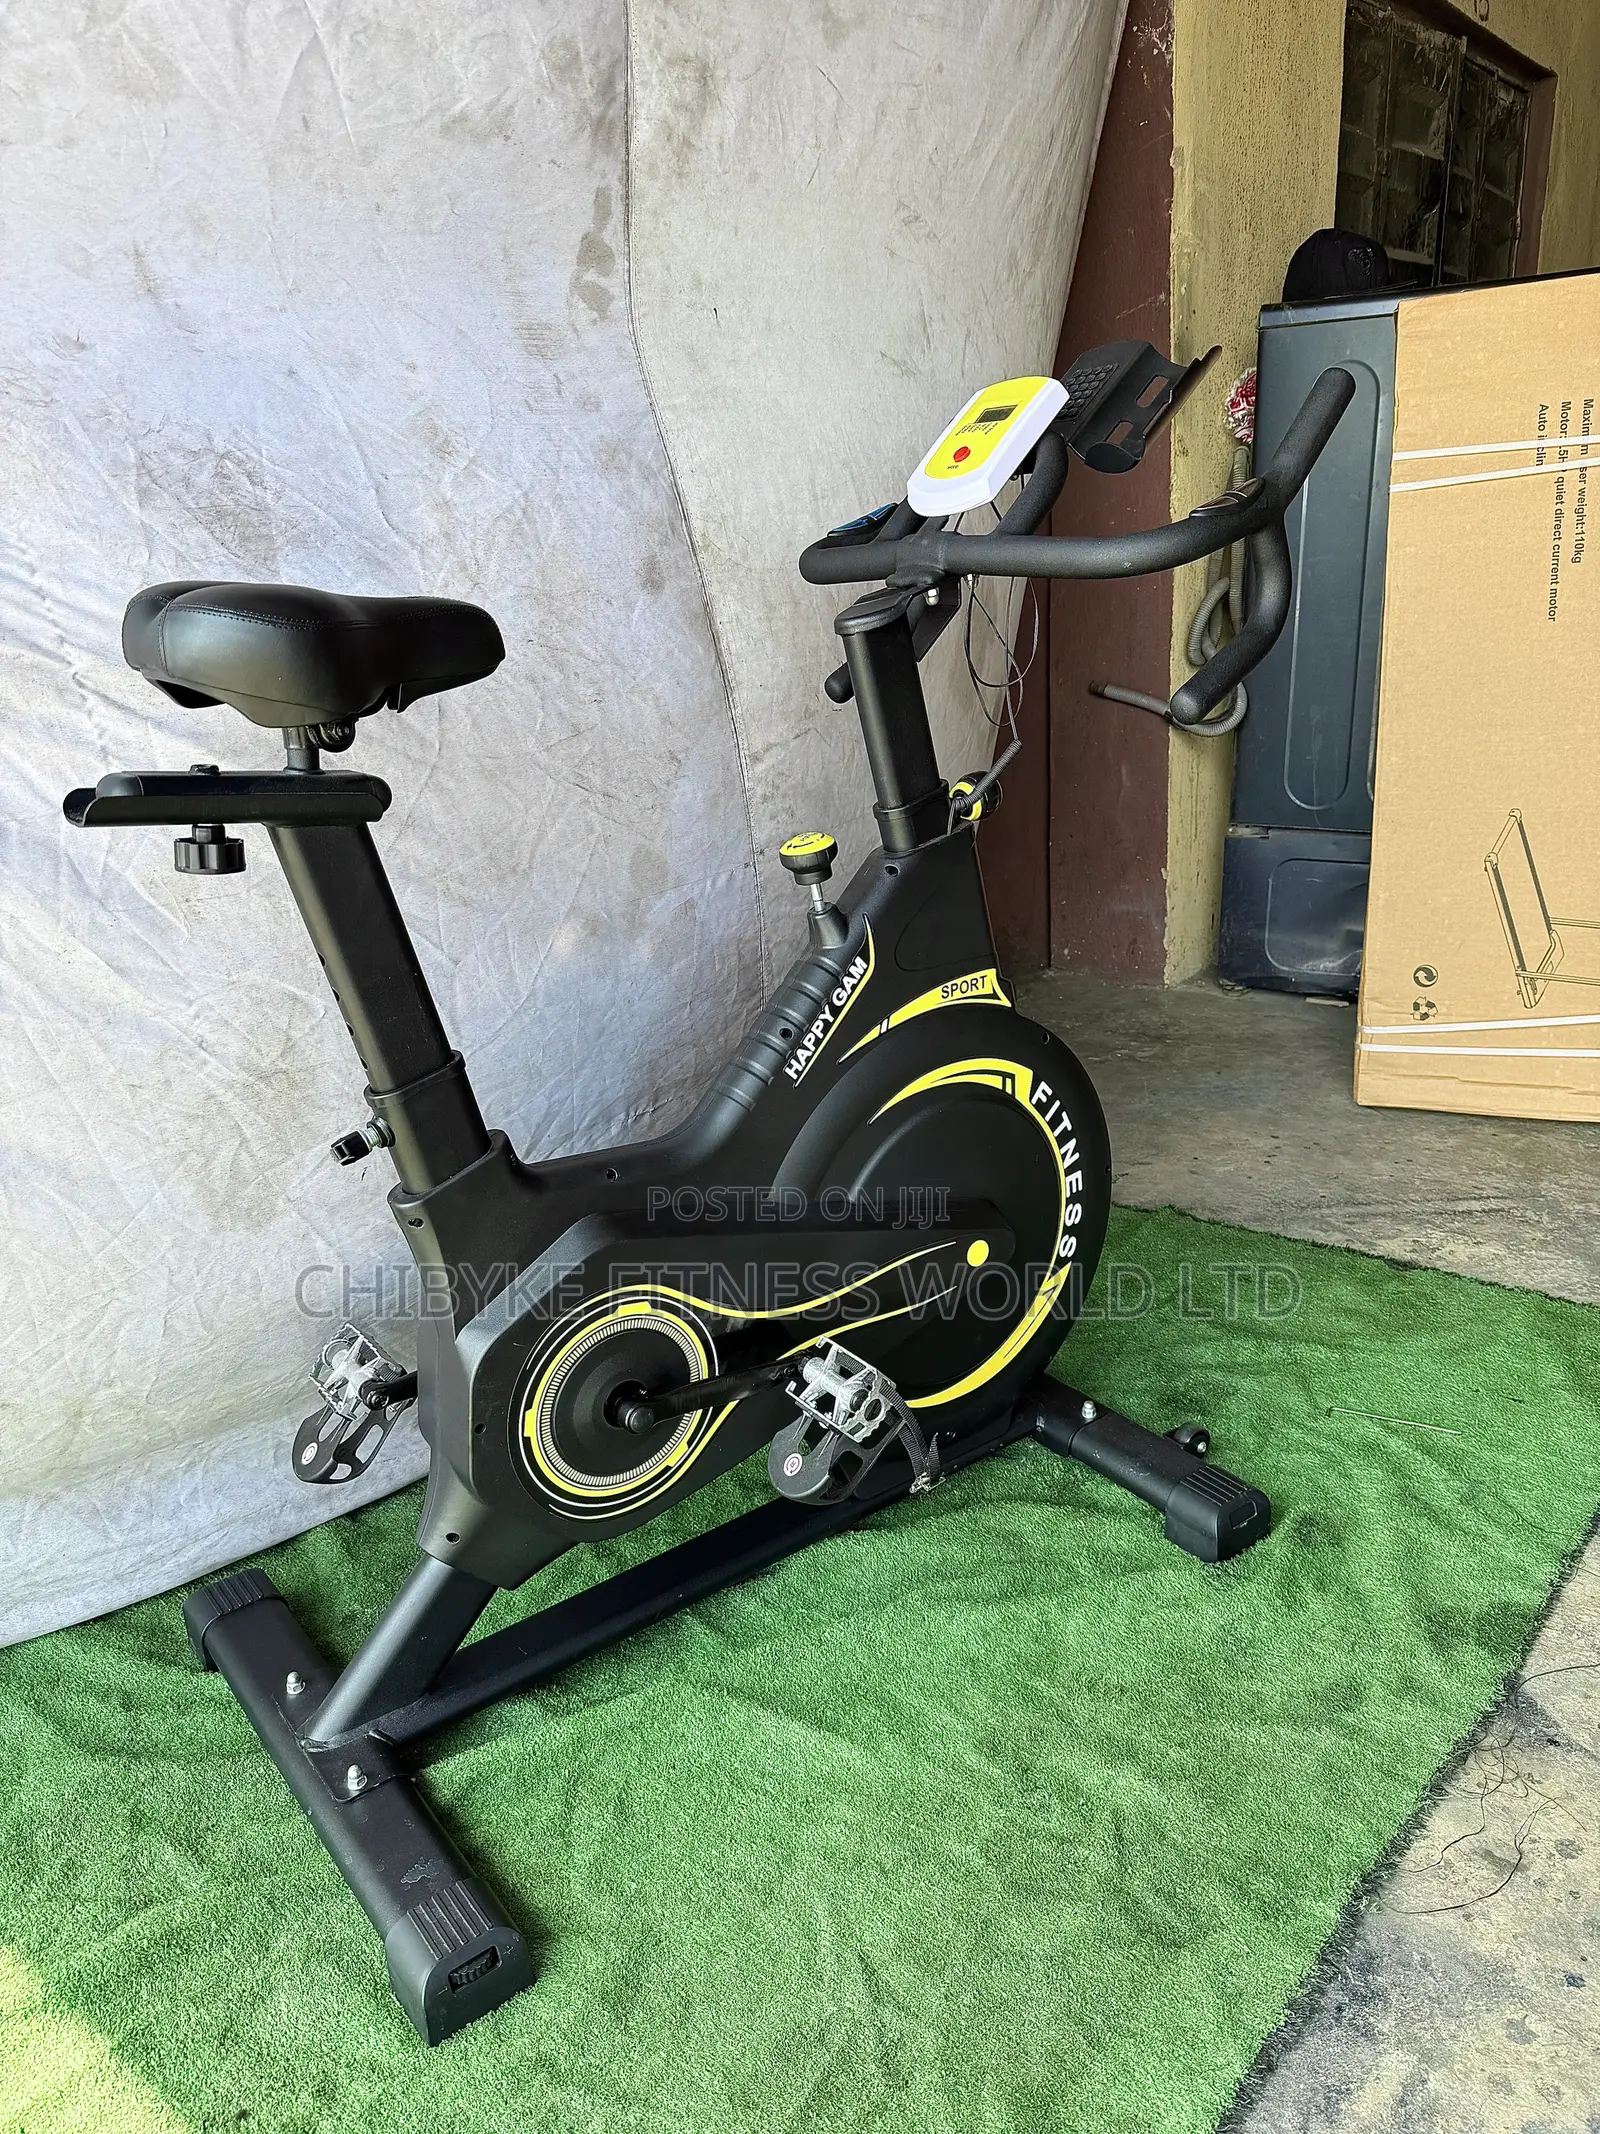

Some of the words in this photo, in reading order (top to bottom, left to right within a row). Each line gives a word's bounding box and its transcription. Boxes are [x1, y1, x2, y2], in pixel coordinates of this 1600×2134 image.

[1537, 404, 1550, 432] Auto
[1580, 398, 1594, 456] Maximm
[1535, 434, 1547, 469] iclin
[1554, 476, 1567, 507] quiet
[1553, 508, 1565, 541] direct
[1571, 487, 1587, 564] weight:110kg
[1550, 543, 1561, 585] current
[1548, 588, 1558, 622] motor
[940, 975, 988, 1000] SPORT
[783, 1005, 835, 1081] HAPPY
[831, 956, 868, 1007] GAM
[1031, 1080, 1083, 1259] FITNESS
